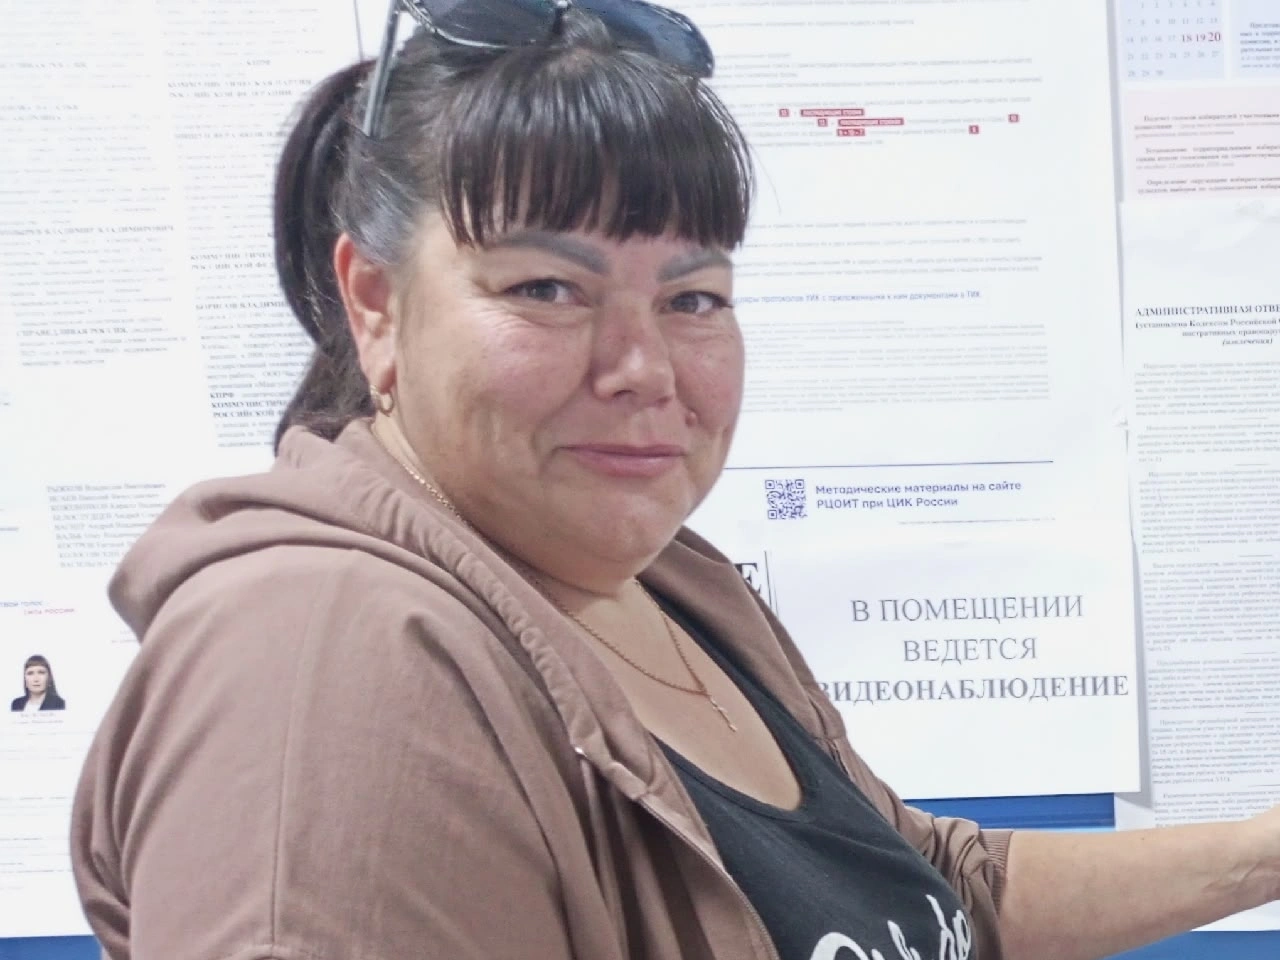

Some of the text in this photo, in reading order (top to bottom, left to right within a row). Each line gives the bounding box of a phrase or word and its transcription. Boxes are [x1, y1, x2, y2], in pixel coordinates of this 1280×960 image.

[1181, 34, 1192, 42] 18
[1196, 33, 1206, 42] 19
[1208, 31, 1221, 42] 20
[1135, 304, 1252, 317] АДМИНИСТРАТИВНАЯ
[816, 481, 1022, 495] Методические материалы на сайте
[817, 496, 958, 510] РЦОИТ при ЦИК России
[851, 594, 1084, 624] В ПОМЕЩЕНИИ
[902, 637, 1038, 666] ВЕДЕТСЯ
